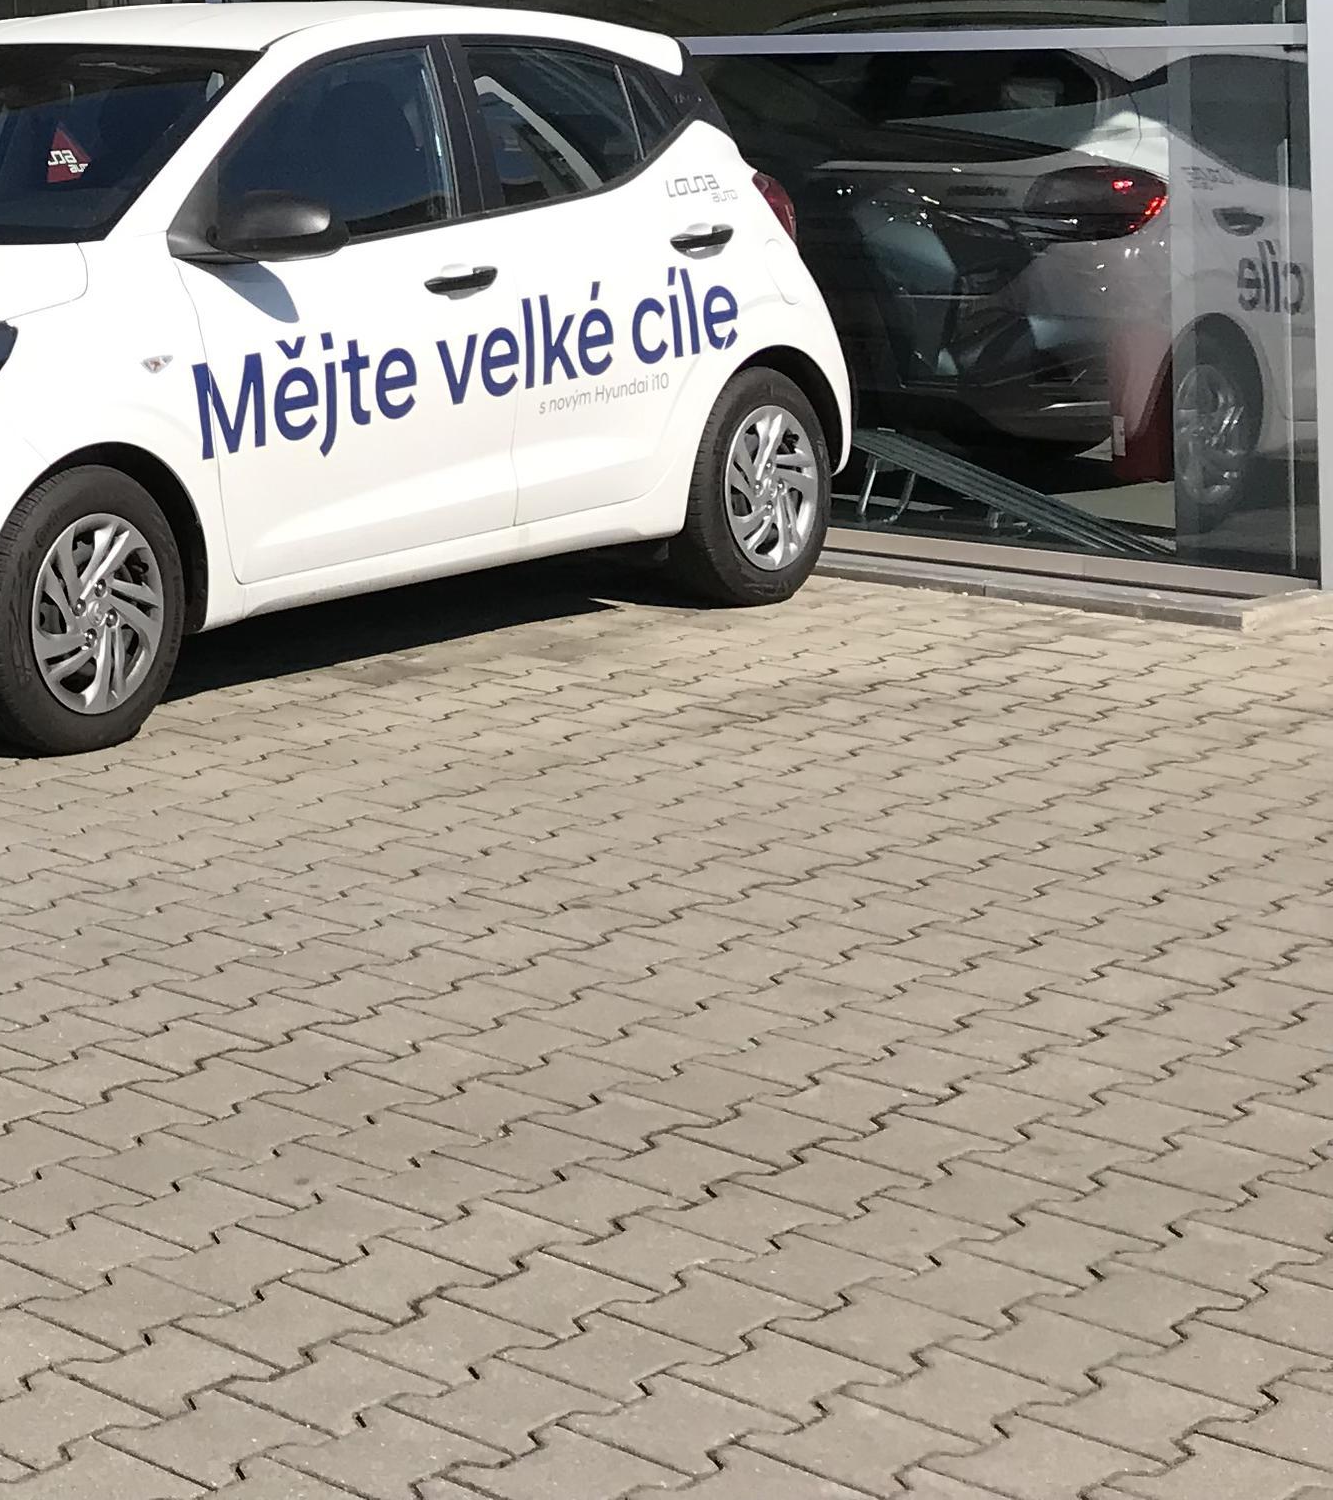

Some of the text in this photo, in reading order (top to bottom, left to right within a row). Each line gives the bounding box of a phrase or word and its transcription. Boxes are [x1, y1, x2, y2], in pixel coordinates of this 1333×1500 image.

[192, 266, 740, 462] Mějte velké cíle
[539, 372, 670, 415] s novým Hyundai i10
